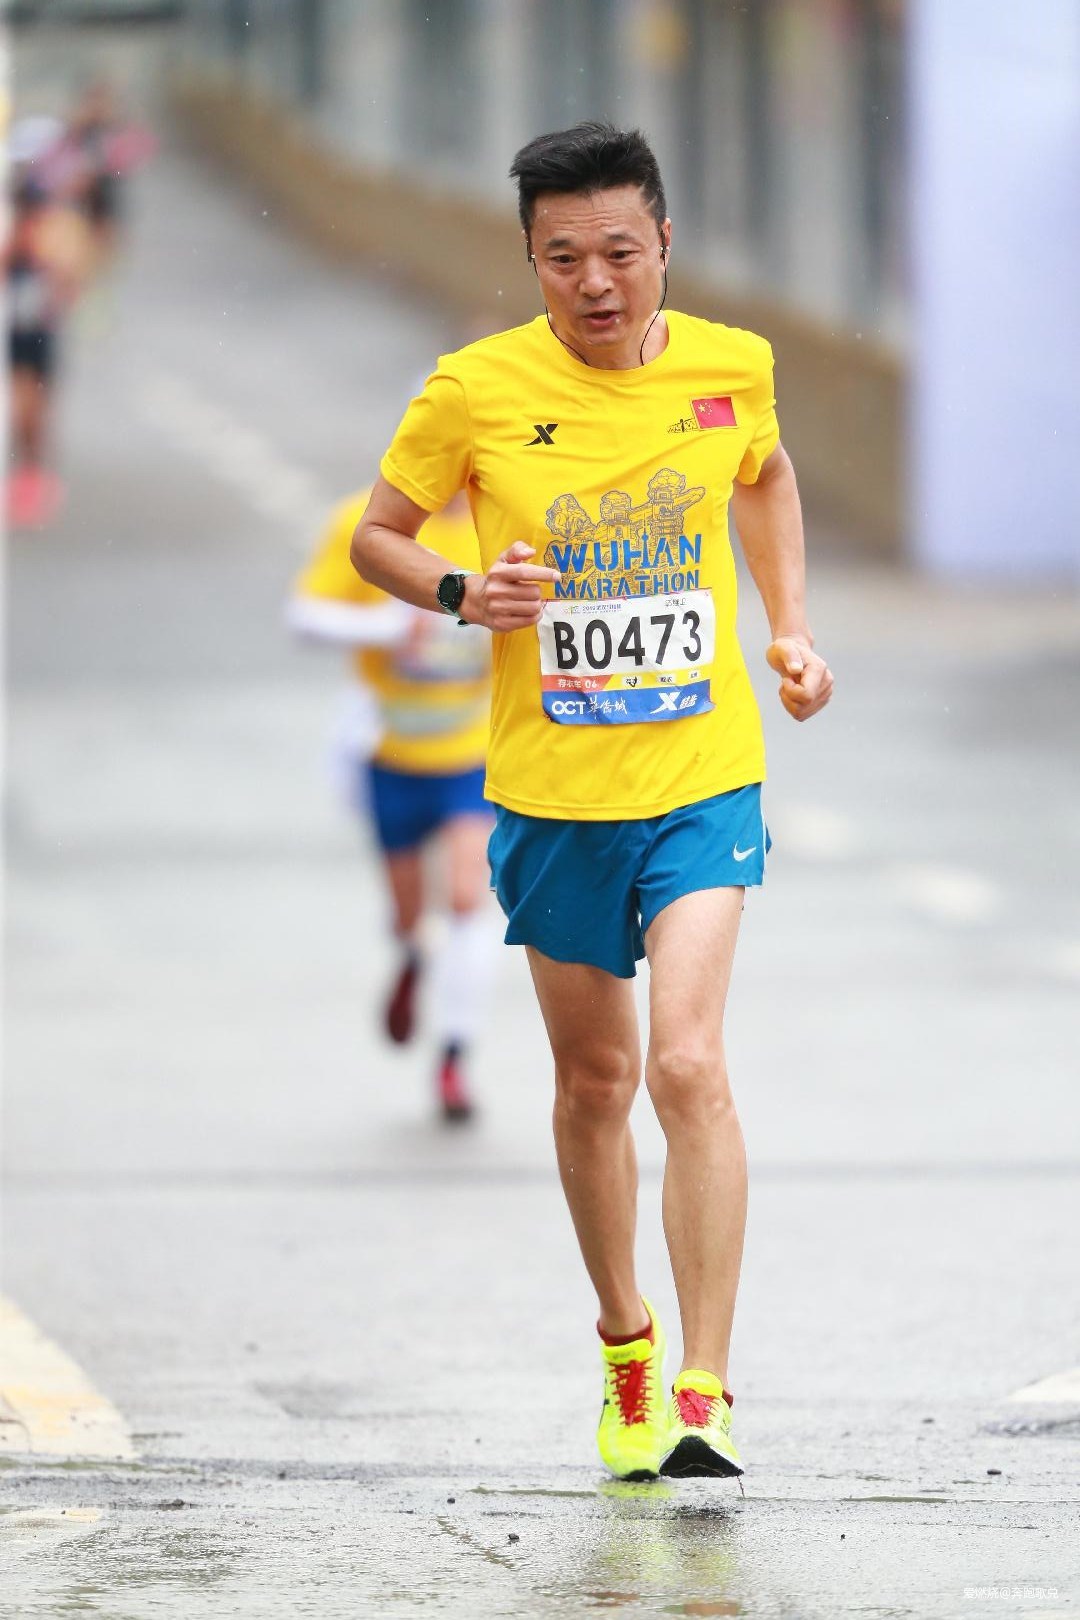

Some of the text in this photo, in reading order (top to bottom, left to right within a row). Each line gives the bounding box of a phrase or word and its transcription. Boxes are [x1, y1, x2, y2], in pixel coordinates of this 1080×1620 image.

[552, 533, 702, 573] WUHAN
[554, 569, 700, 599] MARATHON
[553, 610, 702, 670] B0473
[584, 679, 598, 689] 06
[551, 700, 587, 715] OCT
